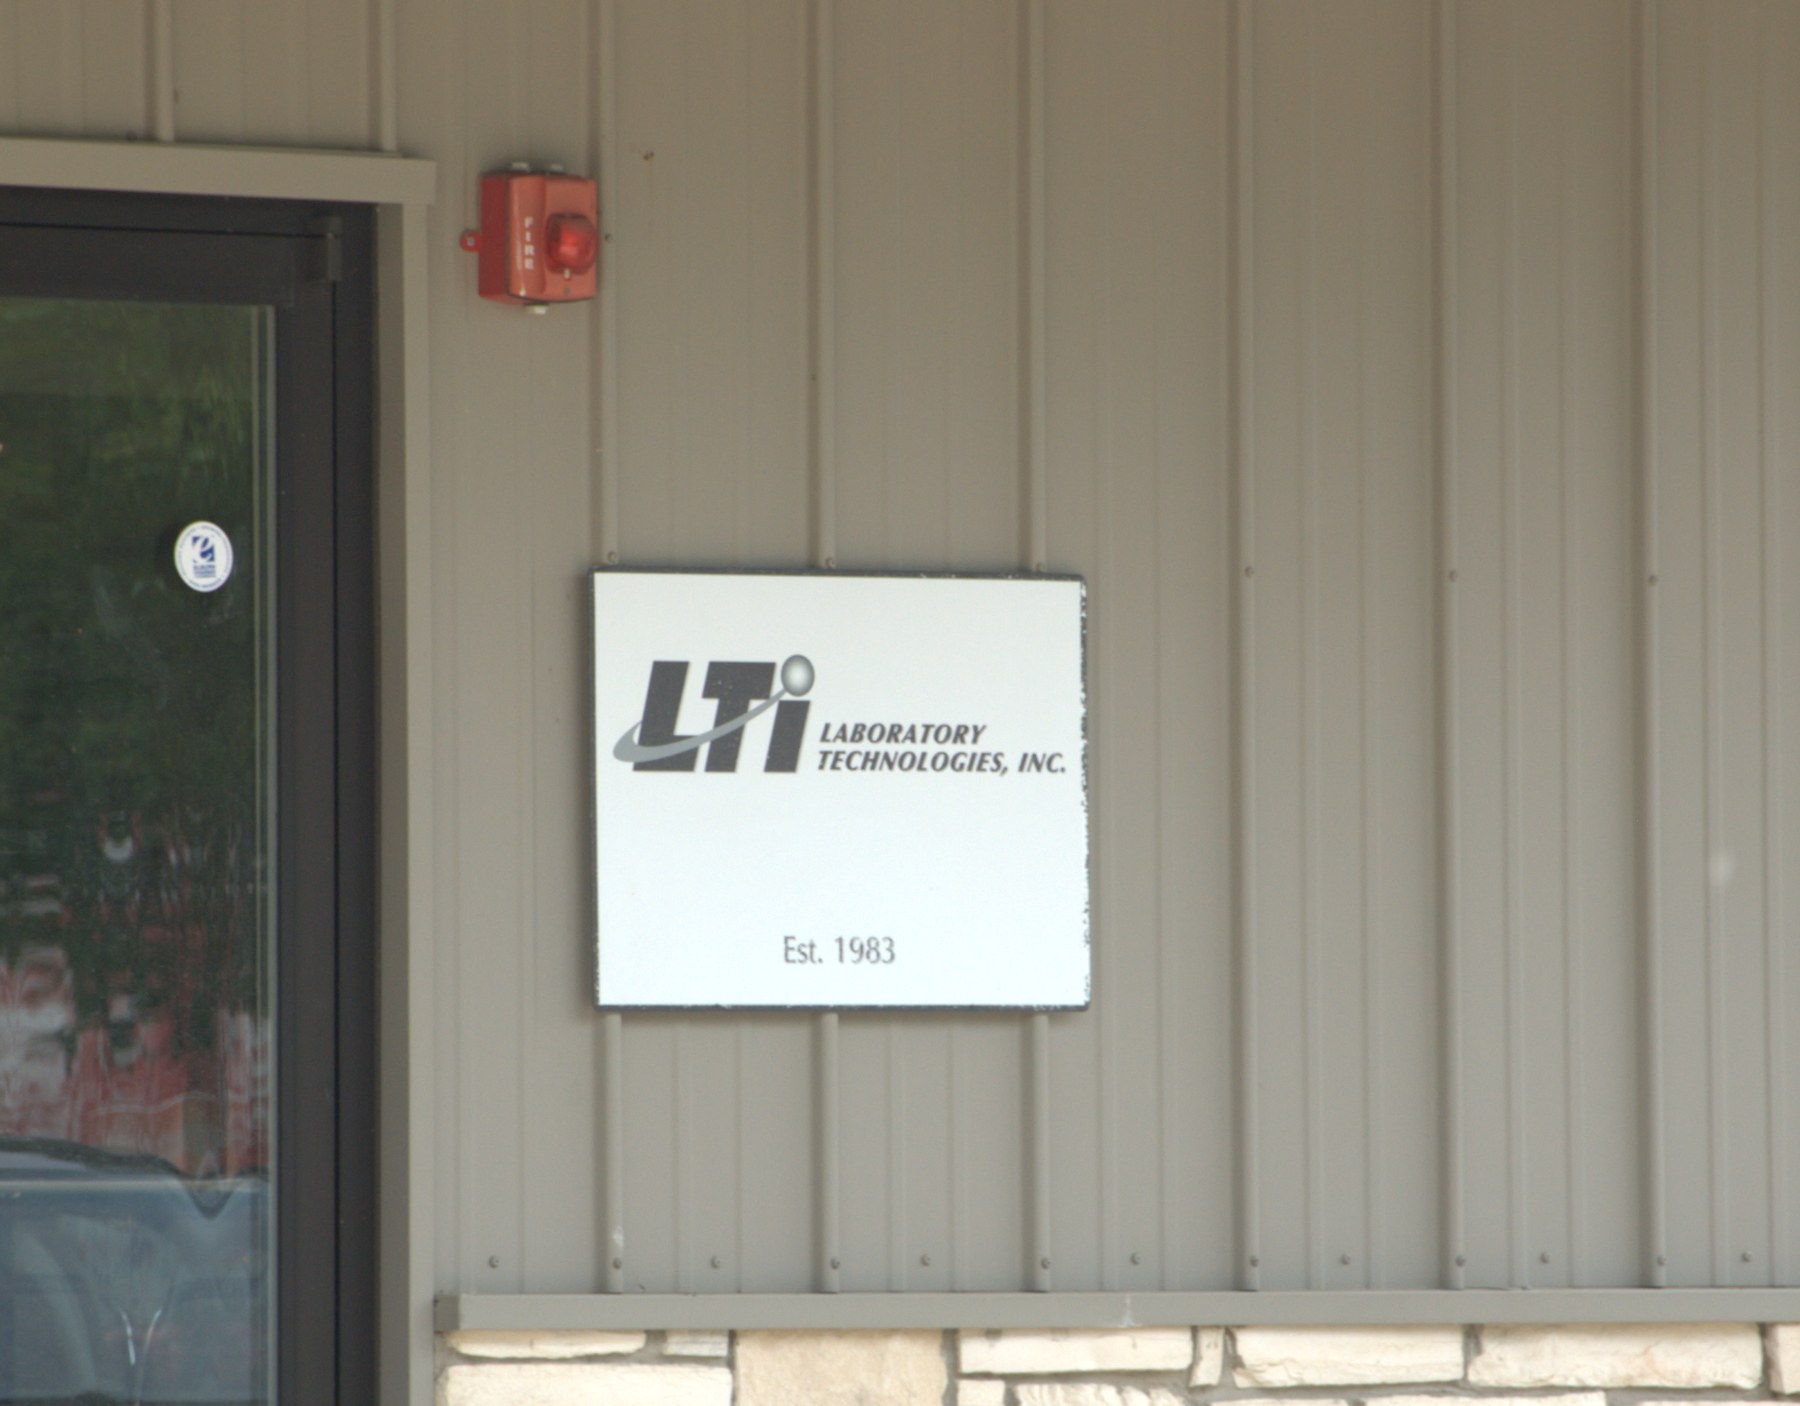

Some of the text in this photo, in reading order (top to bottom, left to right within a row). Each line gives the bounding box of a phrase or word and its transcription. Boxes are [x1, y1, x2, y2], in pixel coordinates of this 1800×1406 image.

[524, 216, 535, 270] FIRE
[819, 722, 986, 744] LABORATORY
[817, 750, 1066, 777] TECHNOLOGIES, INC.
[783, 935, 896, 965] Est. 1983
